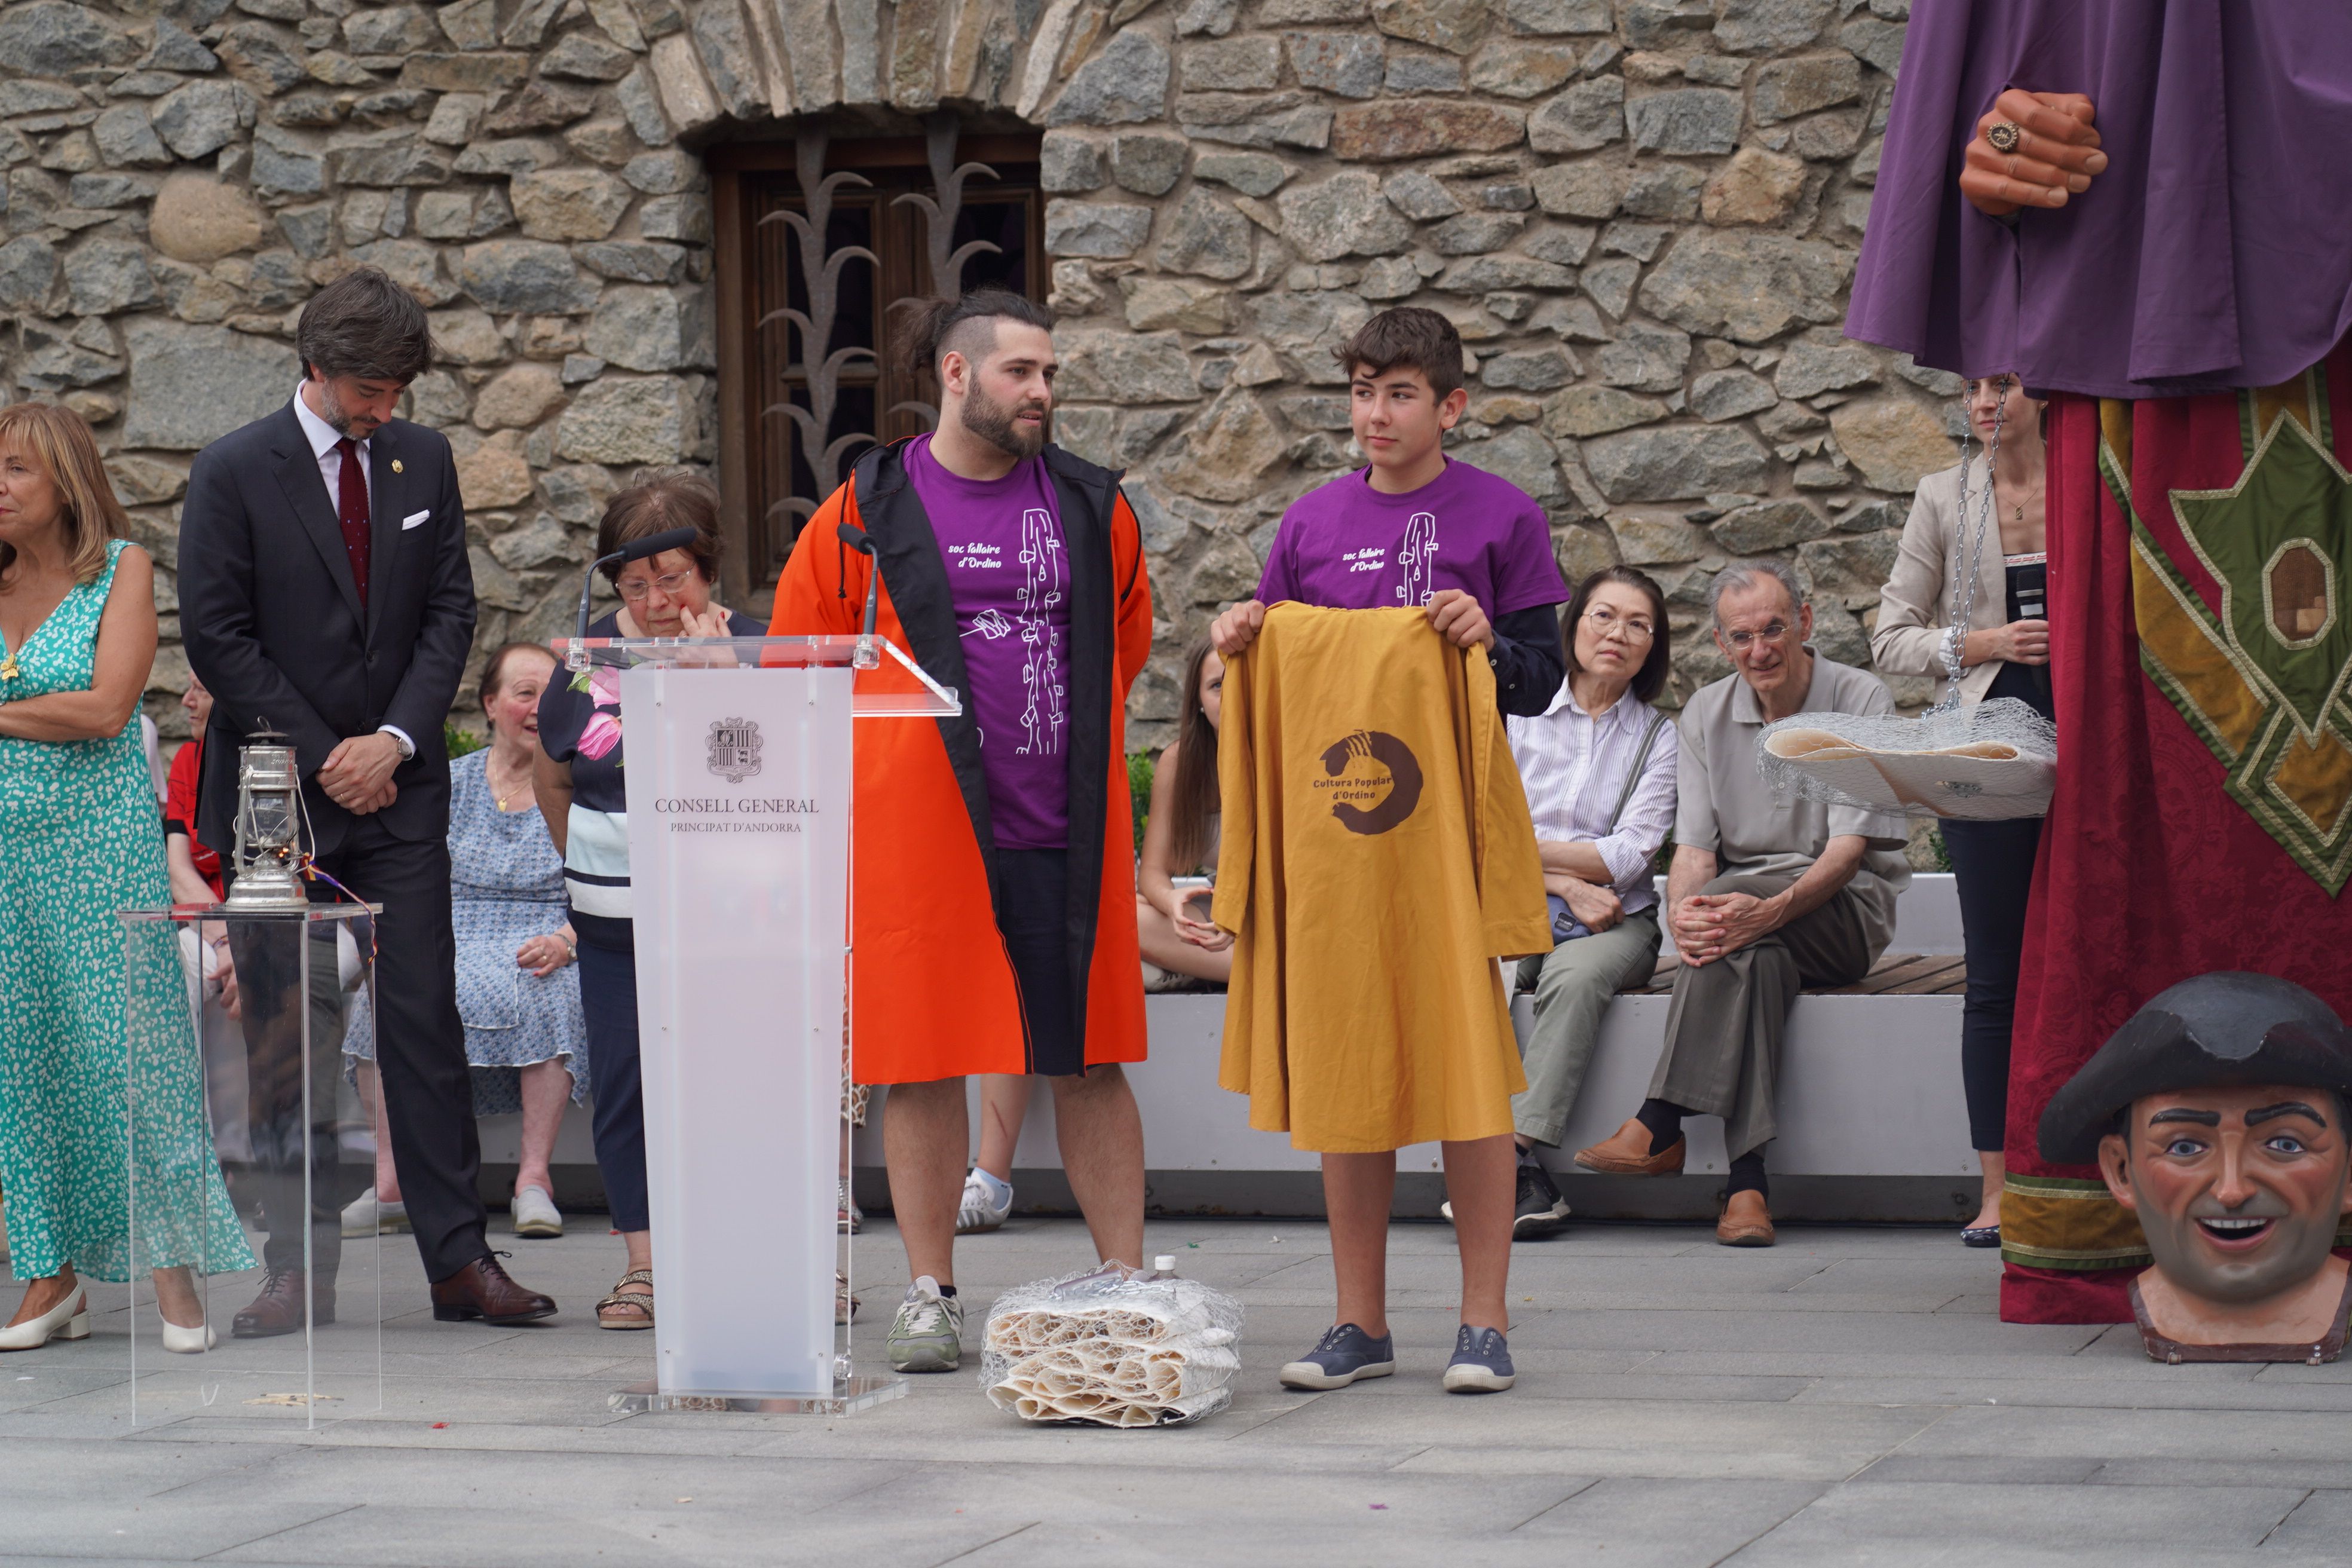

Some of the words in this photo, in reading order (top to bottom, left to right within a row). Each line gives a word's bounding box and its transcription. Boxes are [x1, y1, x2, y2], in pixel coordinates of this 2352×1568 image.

[948, 545, 964, 553] soc
[967, 542, 1000, 554] fallaire
[1358, 547, 1385, 559] fallaire
[958, 556, 1002, 568] d'Ordino
[1350, 560, 1385, 572] d'Ordino
[1313, 779, 1352, 788] Cultura
[1355, 777, 1392, 788] Popular
[1333, 791, 1376, 800] d'Ordino
[655, 798, 734, 813] CONSELL
[738, 798, 819, 813] GENERAL
[670, 823, 731, 832] PRINCIPAT
[733, 822, 801, 832] D'ANDORRA
